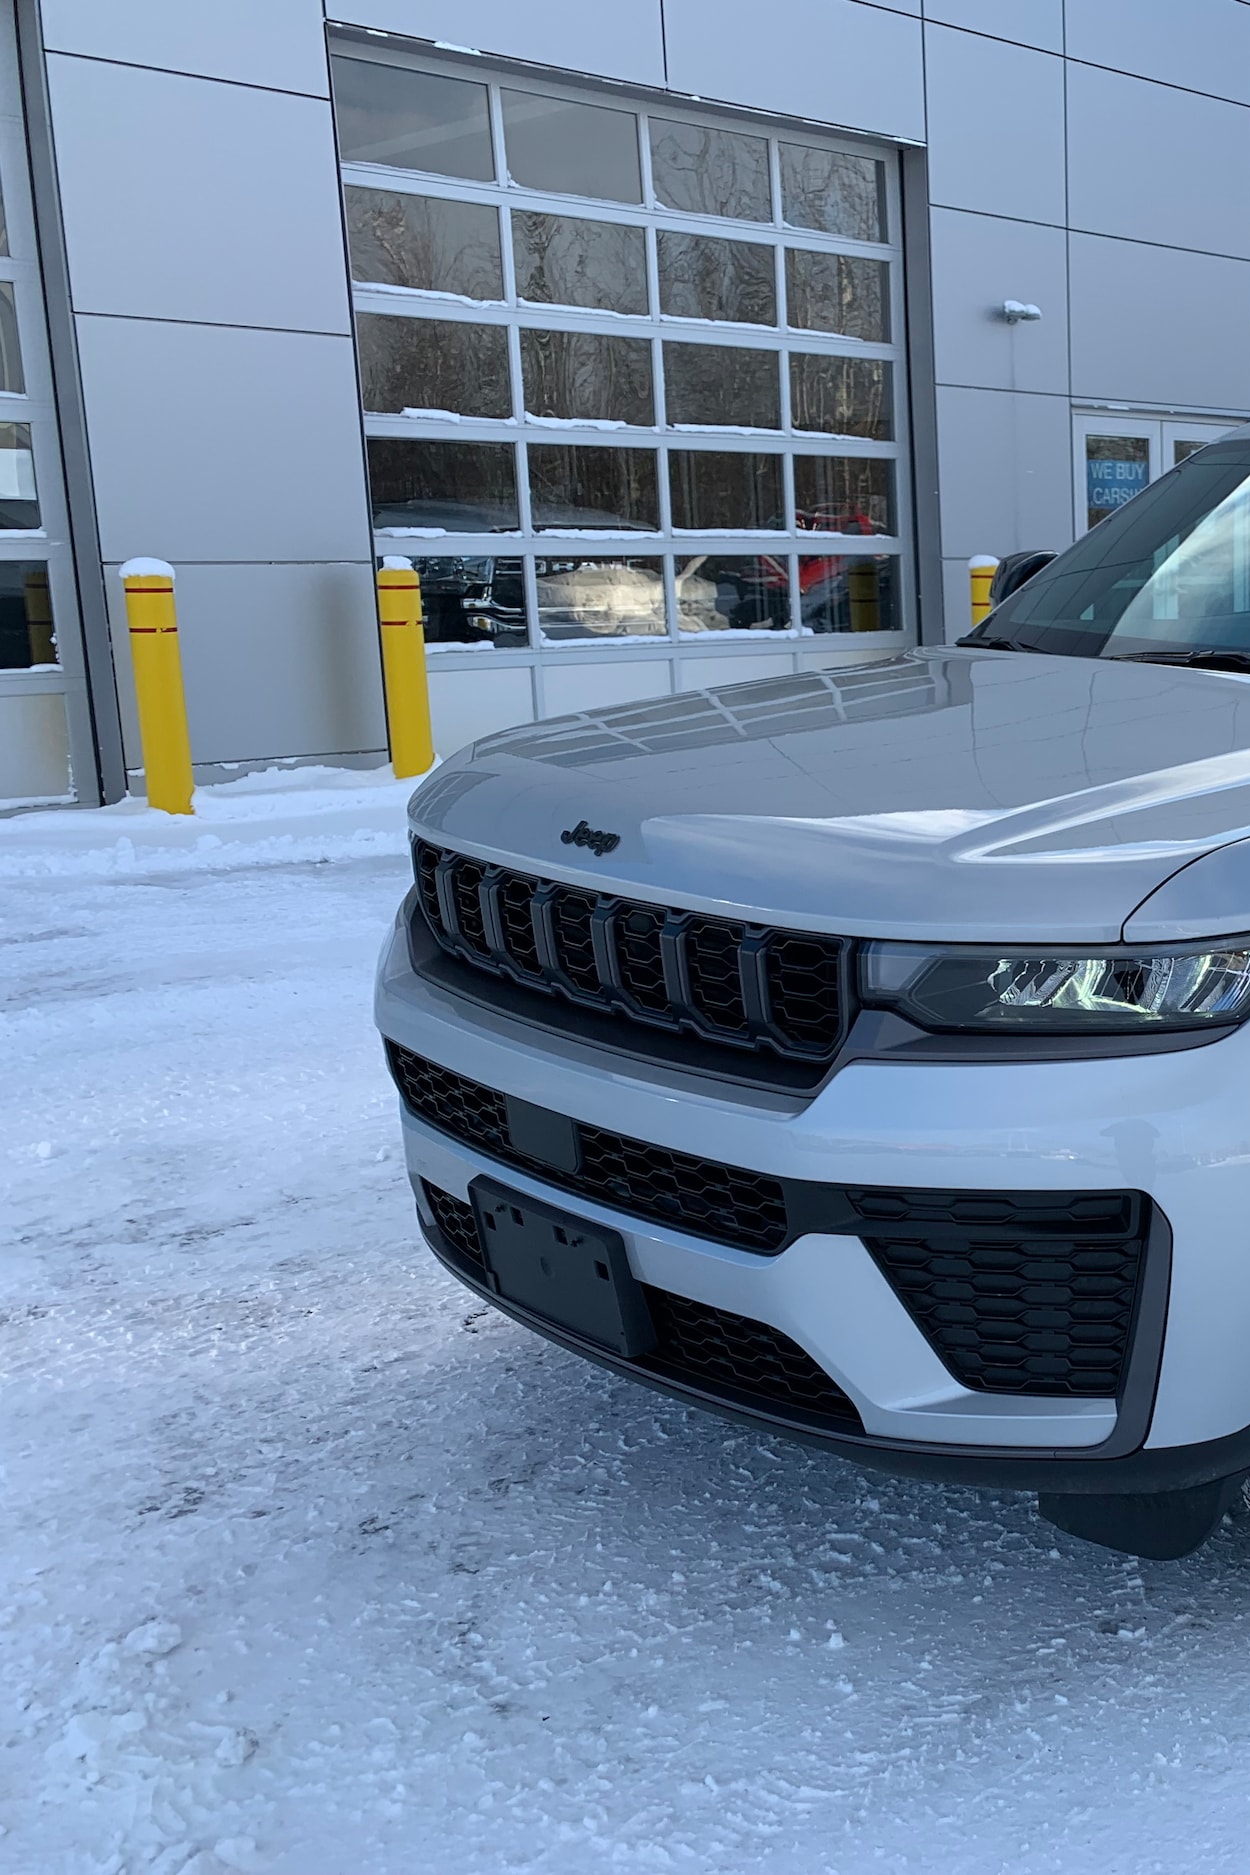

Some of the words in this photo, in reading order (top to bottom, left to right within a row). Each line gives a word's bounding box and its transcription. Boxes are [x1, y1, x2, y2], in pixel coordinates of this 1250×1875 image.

[1091, 462, 1113, 479] WE
[1116, 463, 1145, 480] BUY
[560, 820, 621, 857] Jeep
